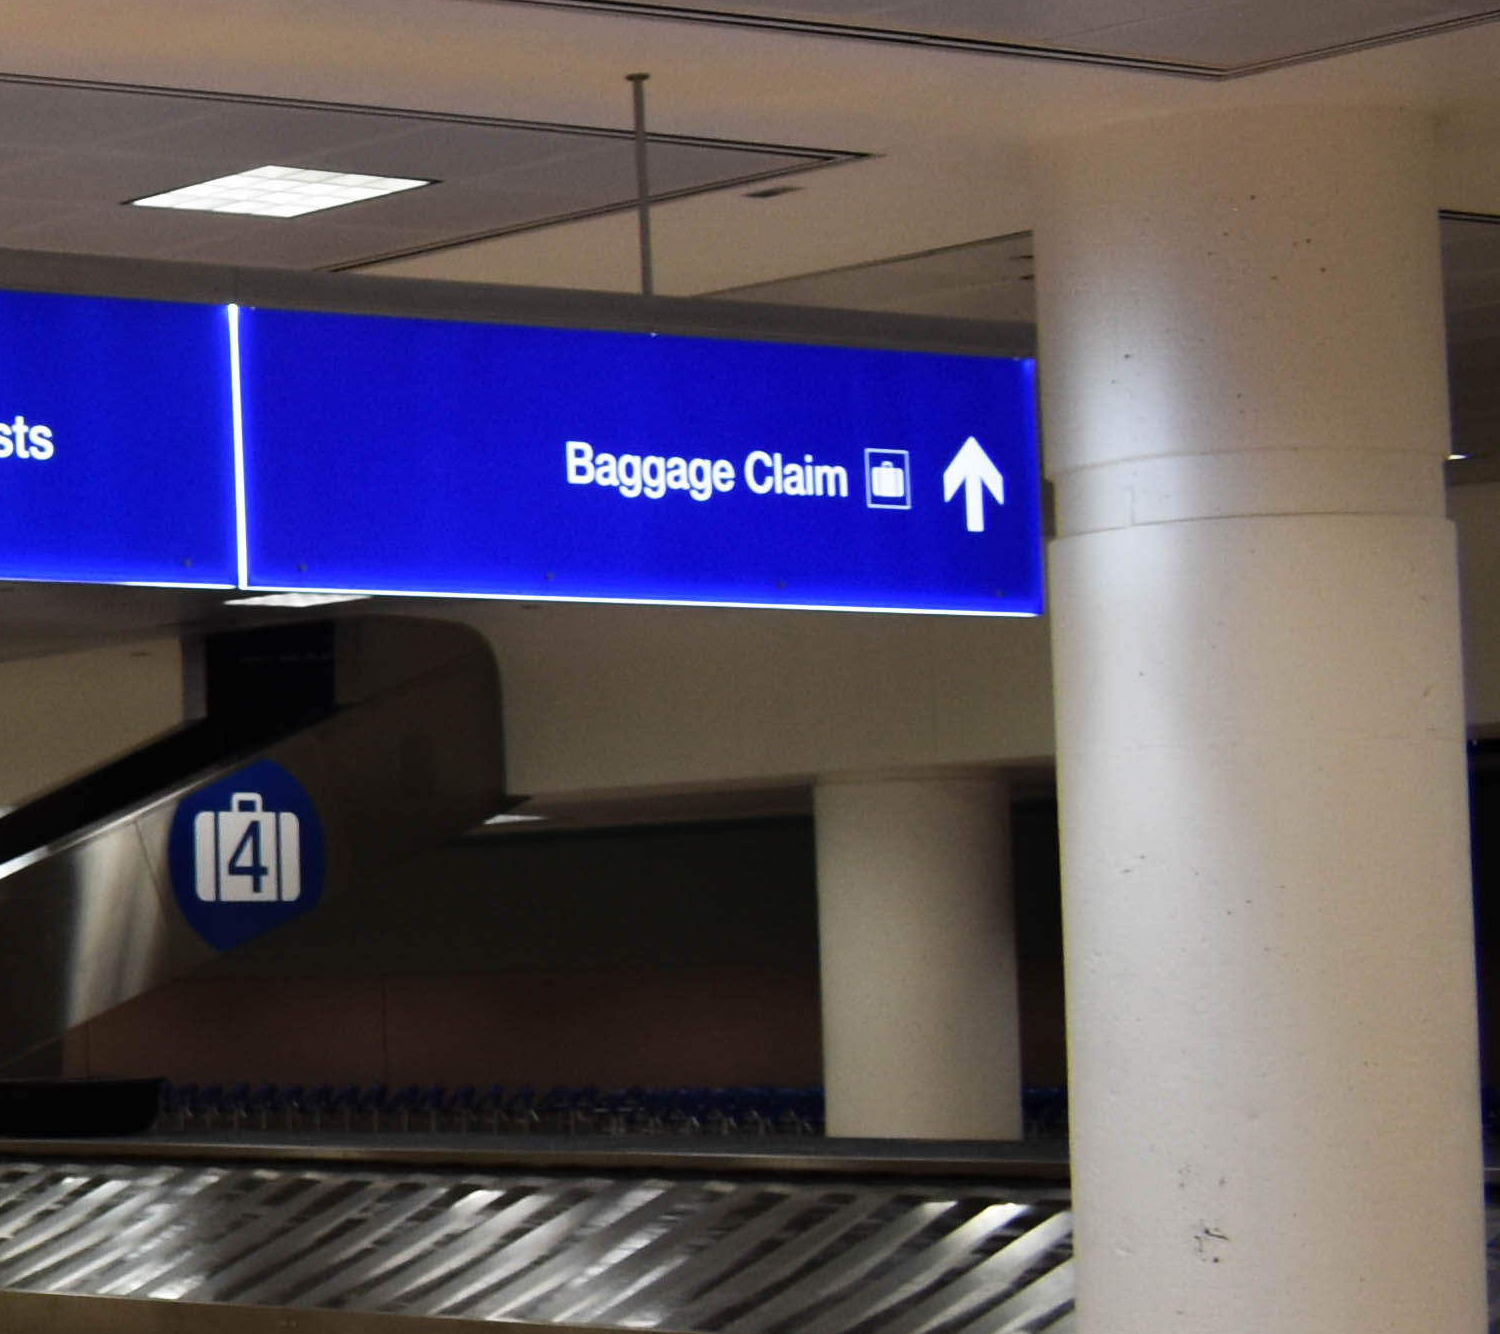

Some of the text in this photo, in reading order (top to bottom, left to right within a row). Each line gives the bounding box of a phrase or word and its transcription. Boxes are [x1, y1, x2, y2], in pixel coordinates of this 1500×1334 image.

[566, 441, 848, 501] Baggage Claim
[229, 821, 268, 893] 4
